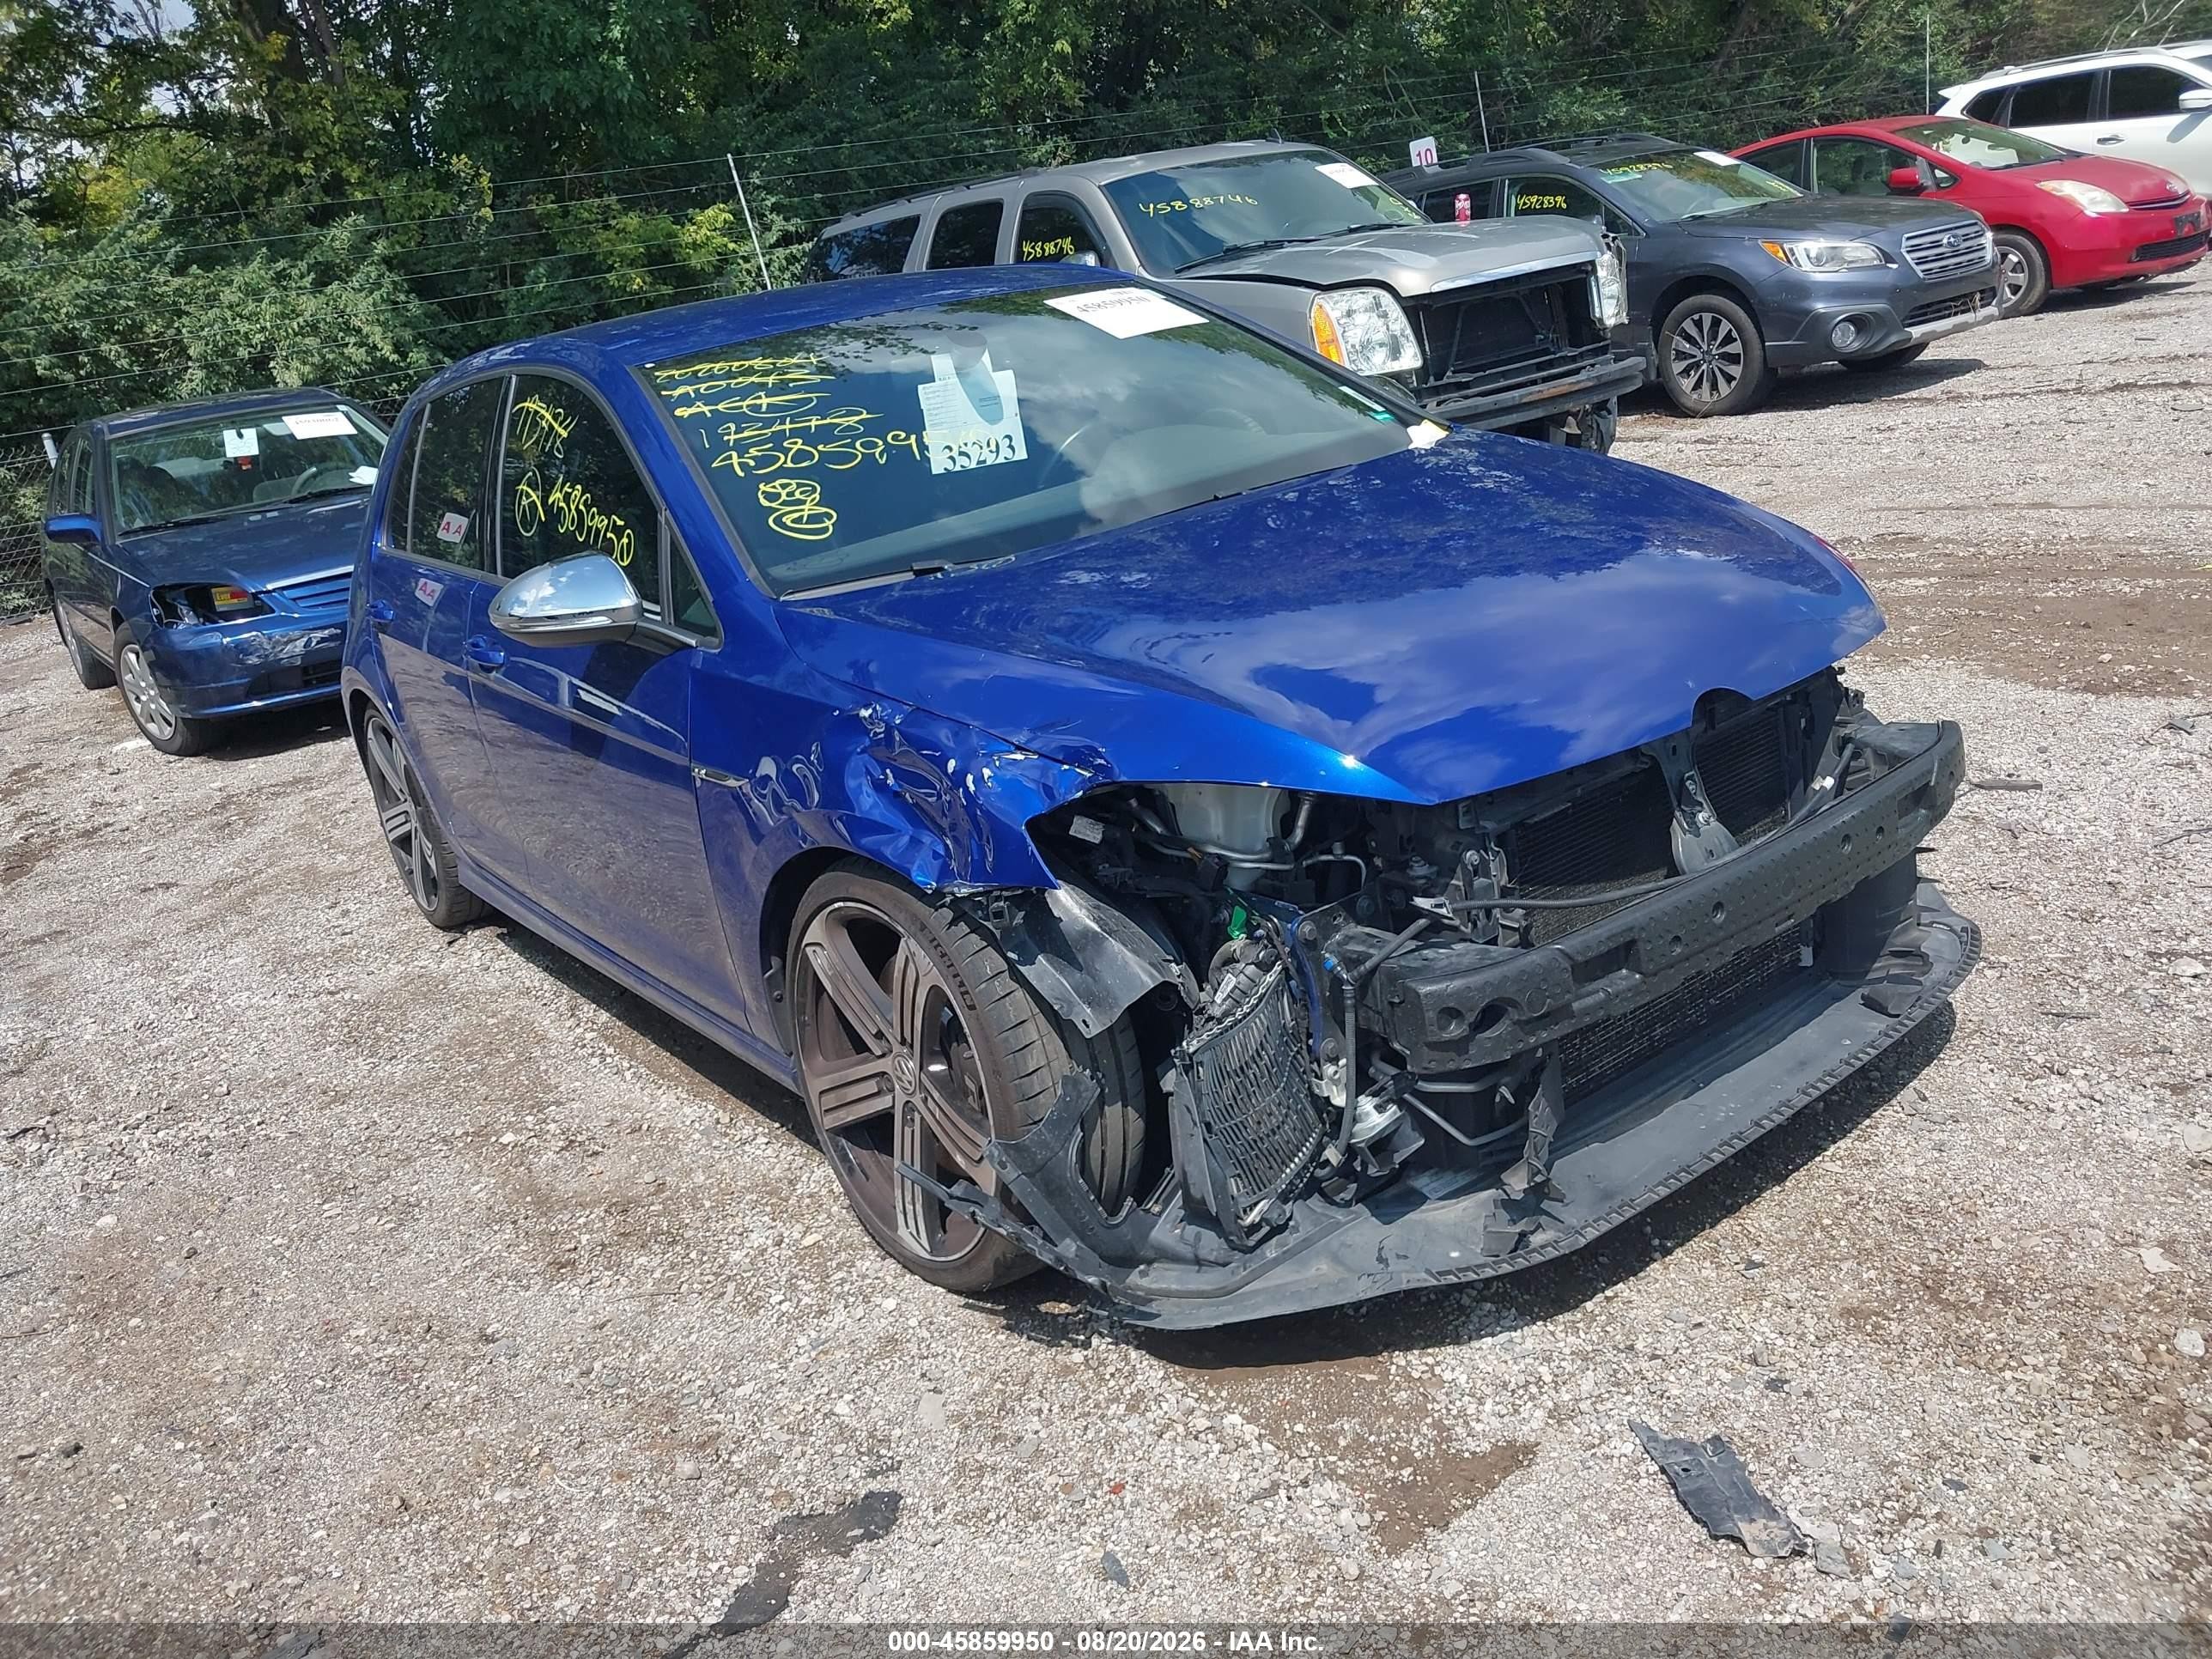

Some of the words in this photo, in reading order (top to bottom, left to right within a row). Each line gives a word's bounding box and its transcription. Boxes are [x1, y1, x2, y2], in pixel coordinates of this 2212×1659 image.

[1415, 148, 1434, 166] 10
[1139, 194, 1259, 218] 45888746
[1516, 194, 1567, 210] 45928396
[1023, 235, 1075, 262] 45888746
[941, 434, 1016, 472] 35293
[548, 474, 635, 567] 45859950
